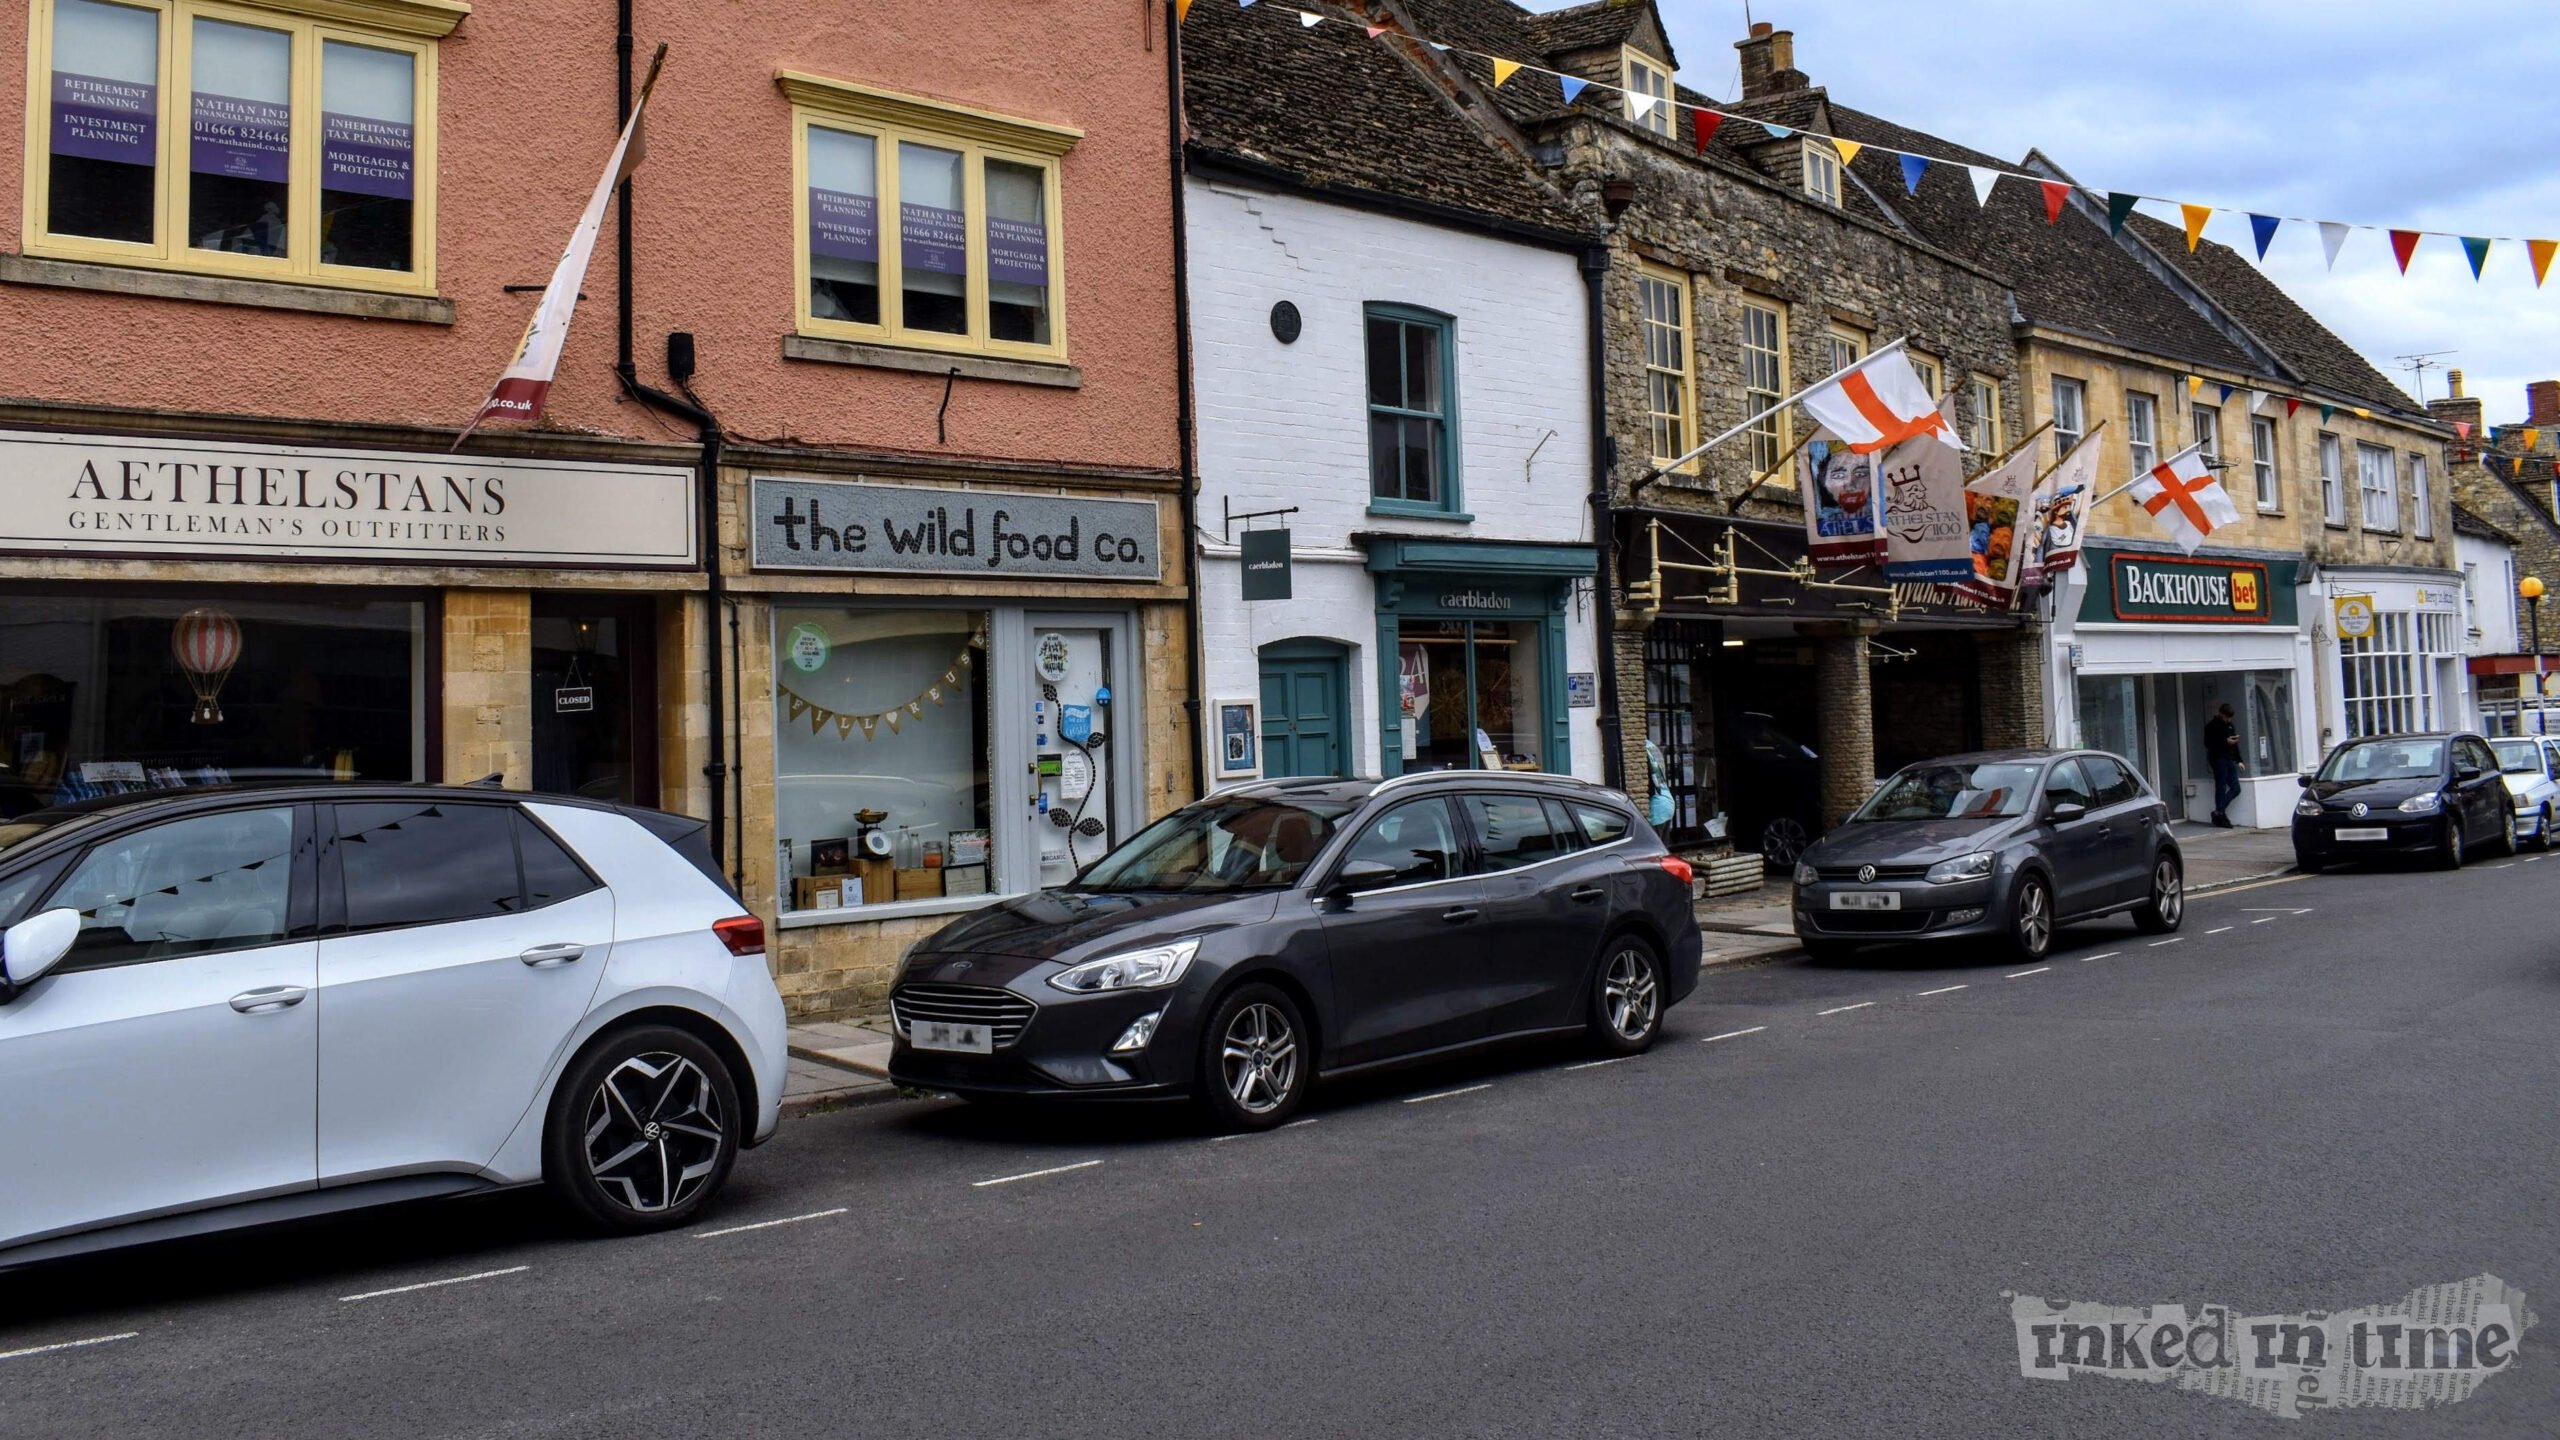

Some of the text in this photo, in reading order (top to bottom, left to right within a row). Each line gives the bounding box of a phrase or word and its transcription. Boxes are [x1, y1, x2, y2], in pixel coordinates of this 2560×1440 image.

[65, 79, 148, 98] RETIREMENT
[73, 92, 139, 109] PLANNING
[196, 98, 288, 119] NATHAN IND
[64, 115, 146, 133] INVESTMENT
[195, 108, 288, 127] FINANCIAL PLANNING
[72, 128, 138, 144] PLANNING
[195, 121, 288, 143] 01666 824646
[331, 118, 409, 137] INHERITANCE
[194, 135, 288, 152] www.nathanind.co.uk
[327, 129, 411, 149] TAX PLANNING
[328, 151, 410, 170] MORTGAGES &
[333, 163, 405, 180] PROTECTION
[817, 193, 872, 209] RETIREMENT
[823, 203, 867, 217] PLANNING
[902, 207, 964, 224] NATHAN IND
[818, 221, 872, 236] INVESTMENT
[902, 226, 965, 243] 01666 824646
[991, 221, 1043, 236] INHERITANCE
[823, 231, 867, 245] PLANNING
[990, 230, 1045, 245] TAX PLANNING
[991, 248, 1038, 261] MORTGAGES
[994, 257, 1042, 270] PROTECTION
[67, 458, 506, 516] AETHELSTANS
[69, 511, 506, 542] GENTLEMAN'S OUTFITTERS
[773, 496, 1145, 568] the wild food co.
[1248, 560, 1284, 570] caerbladon
[1440, 590, 1511, 609] caerbladon
[2233, 578, 2256, 604] bet
[559, 696, 590, 705] CLOSED
